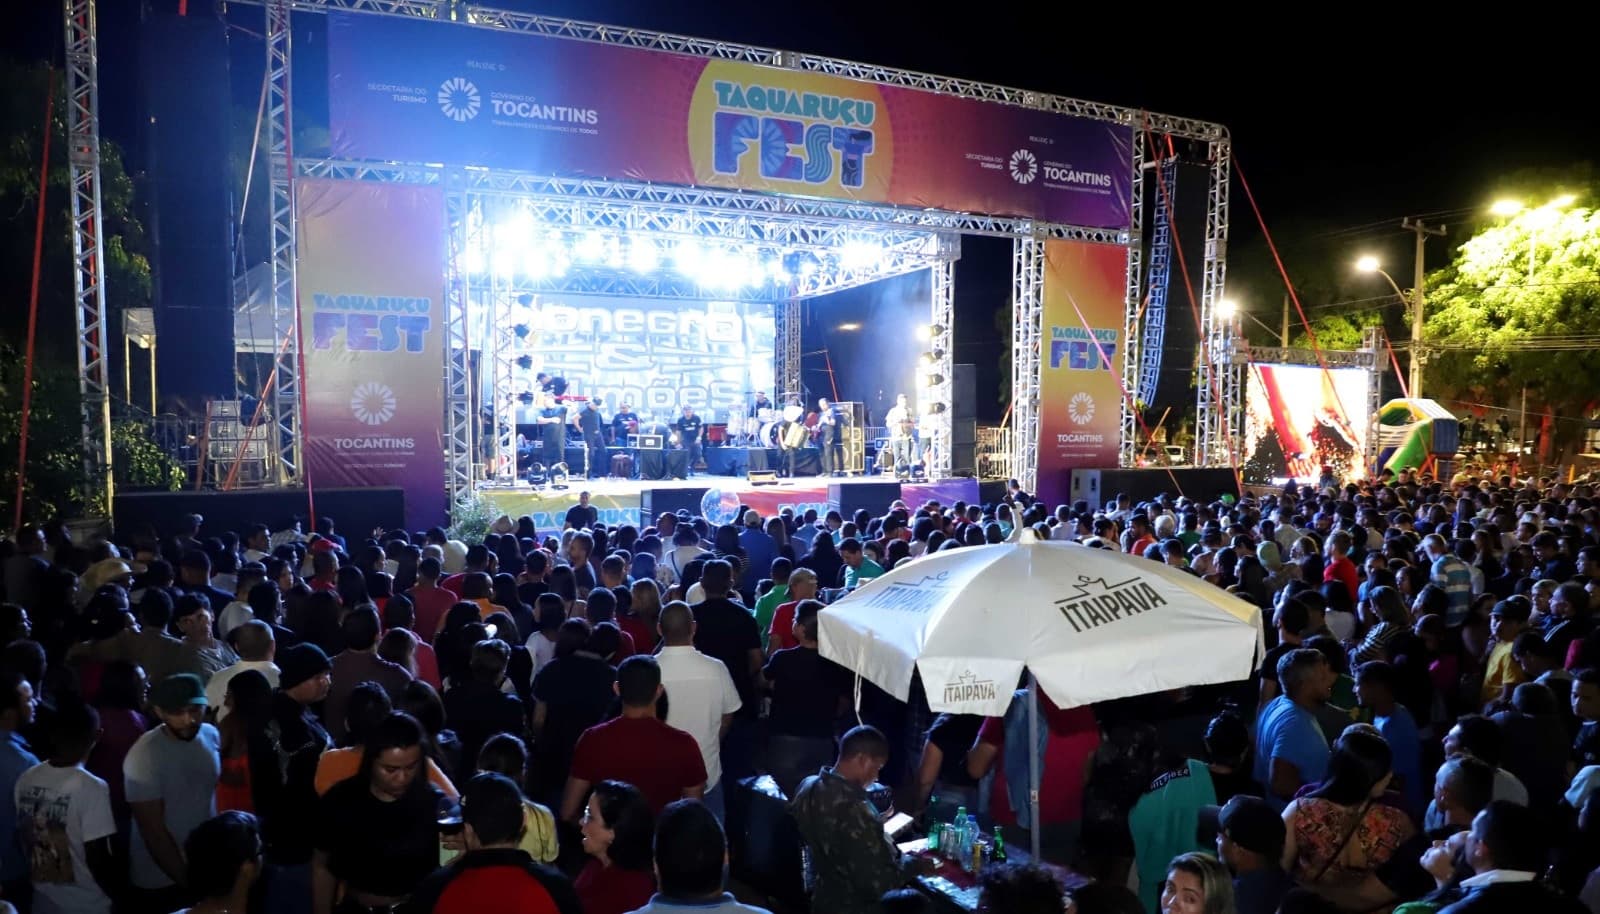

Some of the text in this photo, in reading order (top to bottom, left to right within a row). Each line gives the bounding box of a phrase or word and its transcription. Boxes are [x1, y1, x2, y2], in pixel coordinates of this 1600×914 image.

[491, 100, 598, 125] TOCANTINS
[714, 80, 875, 126] TAQUARUÇU
[713, 112, 874, 188] FEST
[1043, 166, 1112, 187] TOCANTINS
[313, 294, 431, 313] TAQUARUÇU
[312, 311, 431, 353] FEST
[1050, 340, 1117, 371] FEST
[334, 438, 415, 449] TOCANTINS
[1057, 434, 1103, 442] TOCANTINS
[1059, 582, 1168, 633] ITAIPAVA
[943, 683, 996, 704] ITAIPAVA
